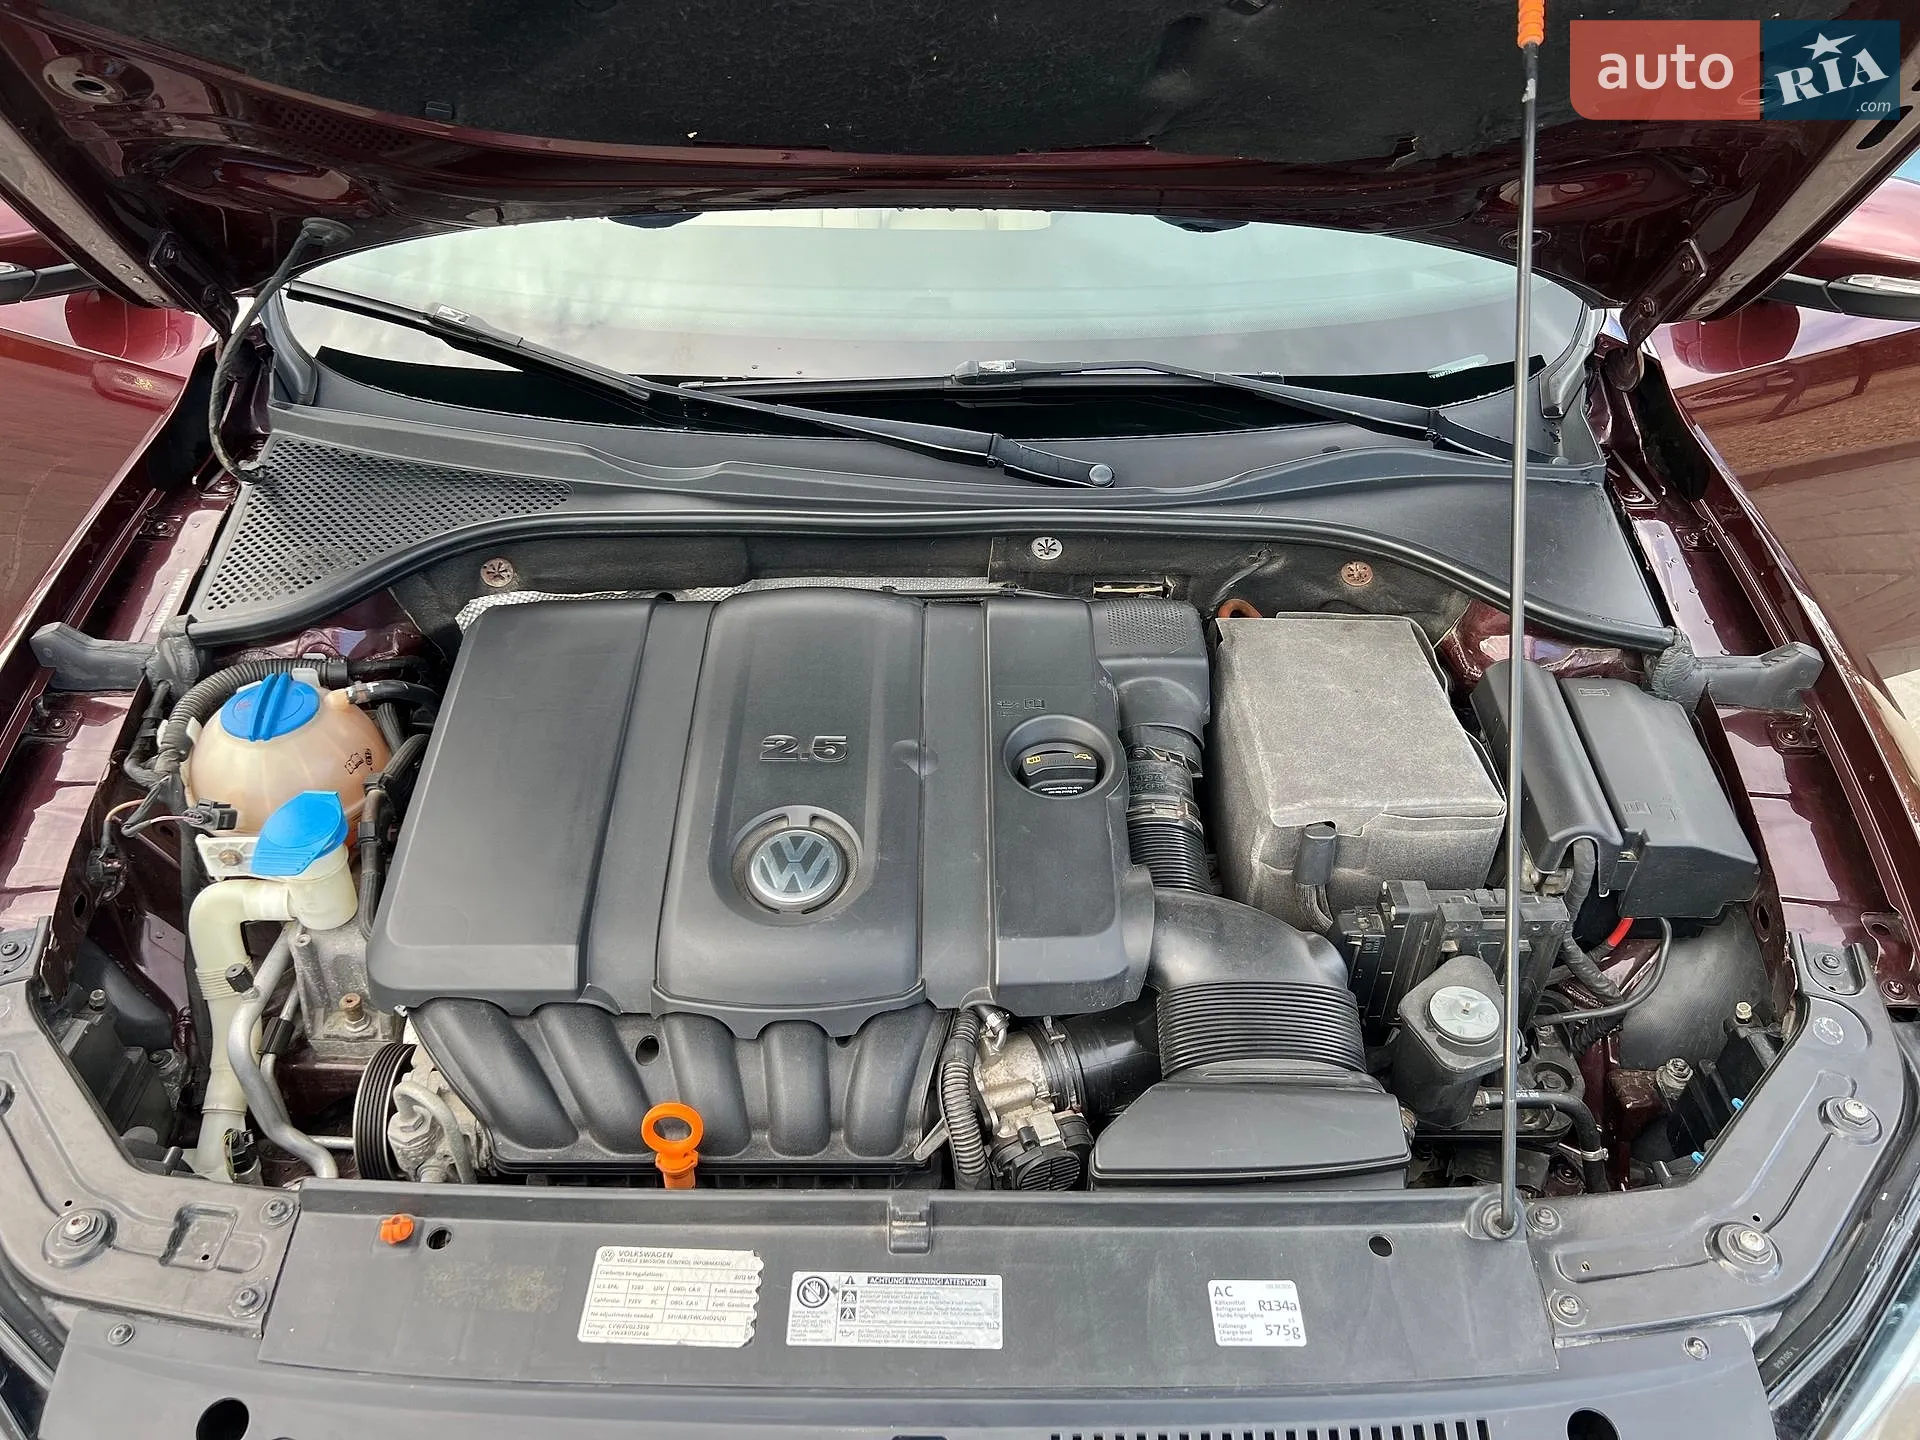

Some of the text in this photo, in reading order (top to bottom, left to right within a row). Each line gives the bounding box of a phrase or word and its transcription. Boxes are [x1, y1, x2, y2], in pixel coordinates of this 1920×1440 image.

[760, 734, 848, 762] 2.5
[618, 1250, 674, 1258] VOLKSWAGEN
[1258, 1299, 1298, 1312] R134a
[1264, 1323, 1301, 1340] 575g
